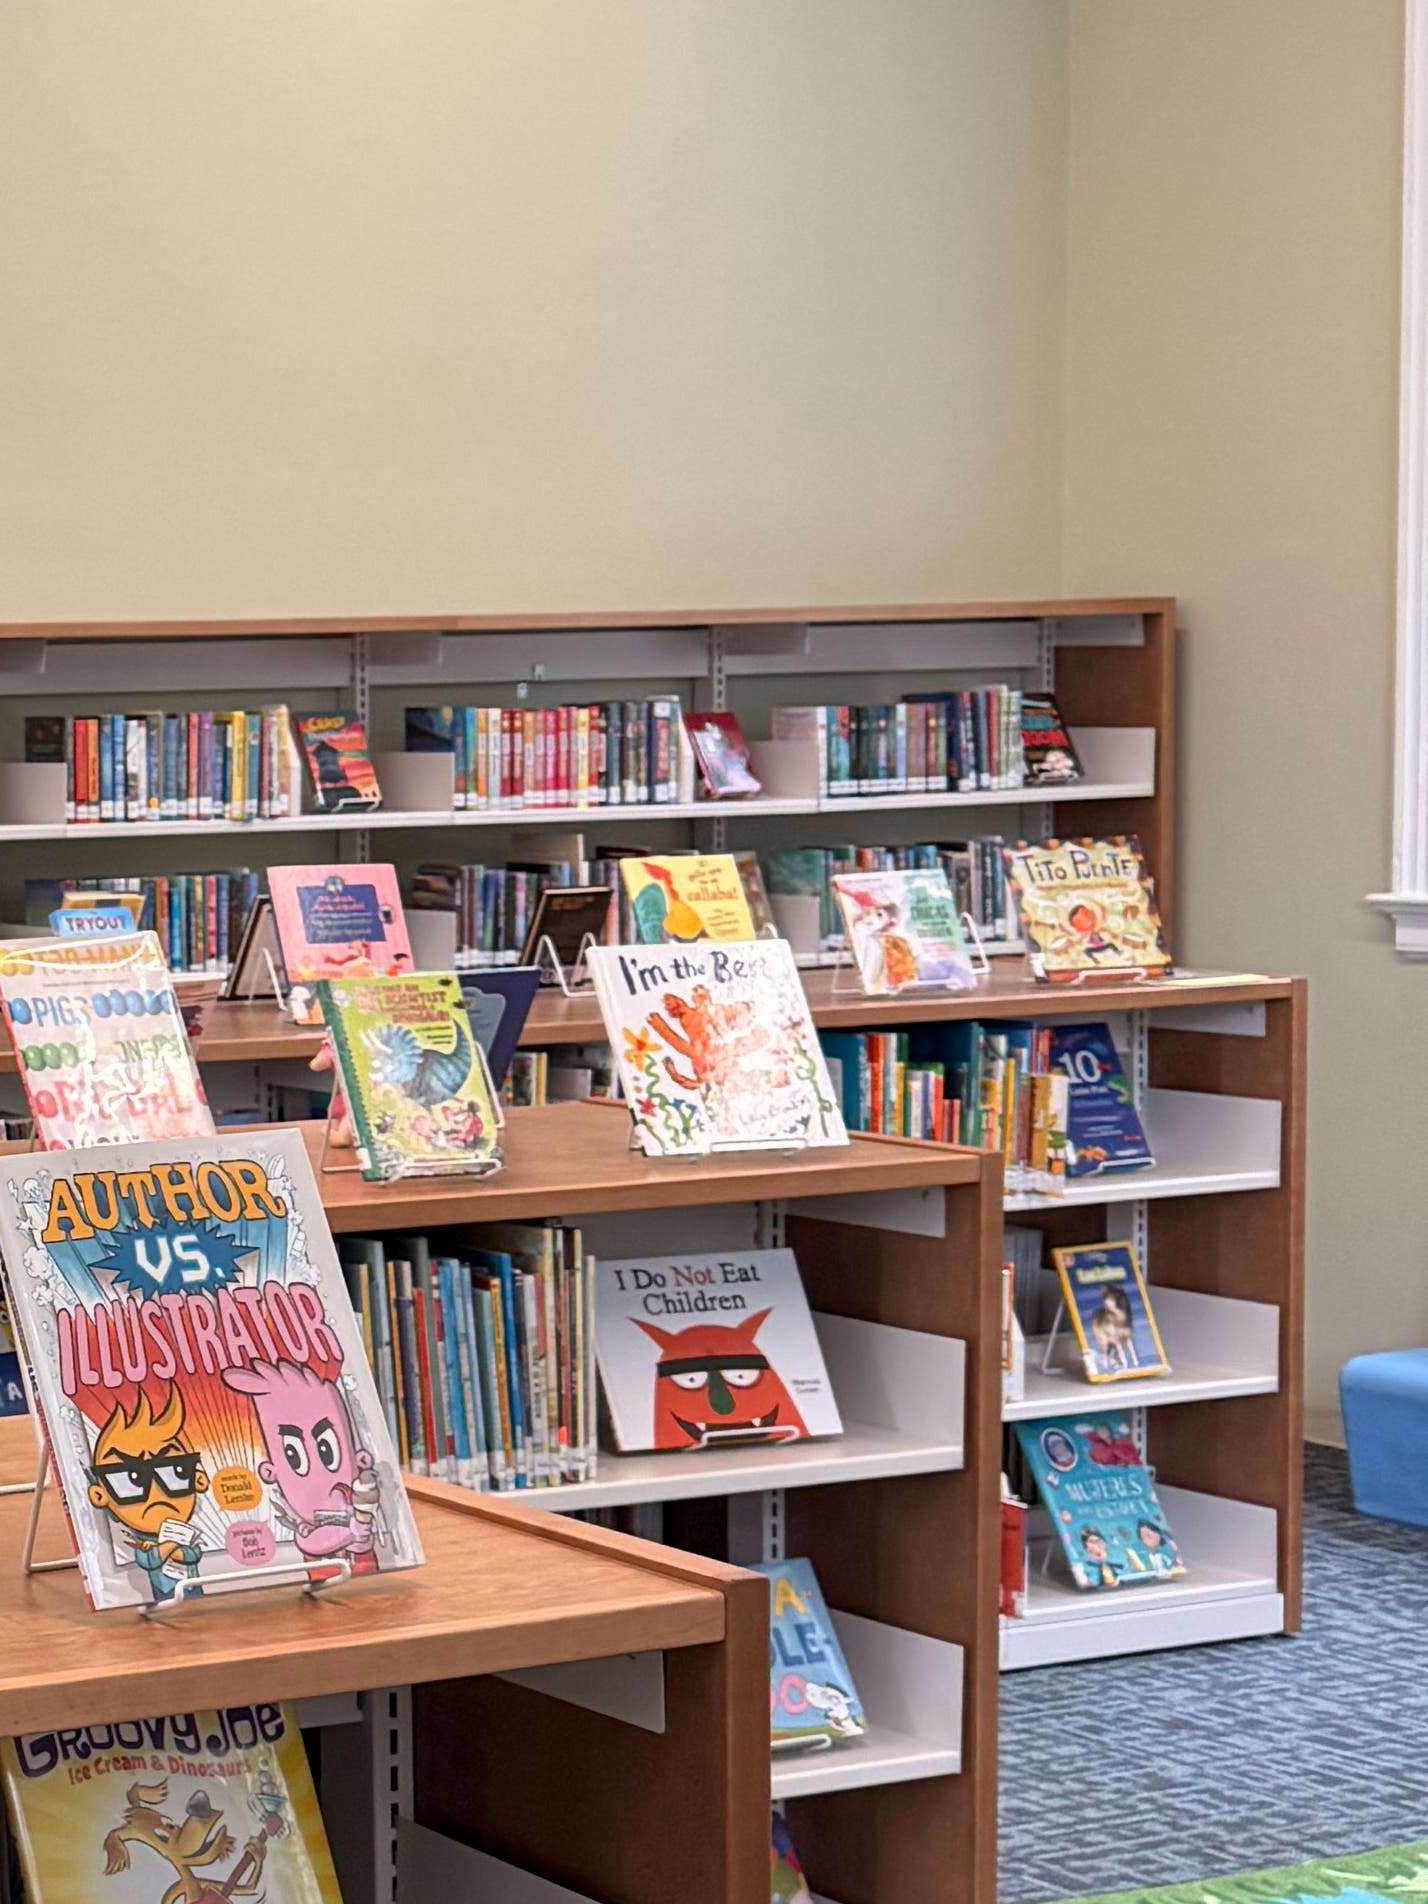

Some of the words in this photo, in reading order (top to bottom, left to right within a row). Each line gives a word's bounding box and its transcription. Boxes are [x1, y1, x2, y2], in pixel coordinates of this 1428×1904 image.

[65, 915, 128, 932] TRYOUT
[619, 955, 669, 996] I'm
[670, 956, 706, 979] the
[1058, 1050, 1103, 1085] 10
[40, 1159, 287, 1243] AUTHOR
[135, 1232, 225, 1285] VS.
[614, 1270, 628, 1291] I
[630, 1269, 666, 1290] Do
[670, 1264, 717, 1287] Not
[718, 1262, 762, 1284] Eat
[643, 1292, 747, 1316] Children
[57, 1280, 344, 1396] ILLUSTRATOR
[68, 1766, 92, 1786] Ice
[94, 1753, 148, 1777] Cream
[150, 1753, 165, 1770] &
[168, 1754, 252, 1777] Dinosaurs
